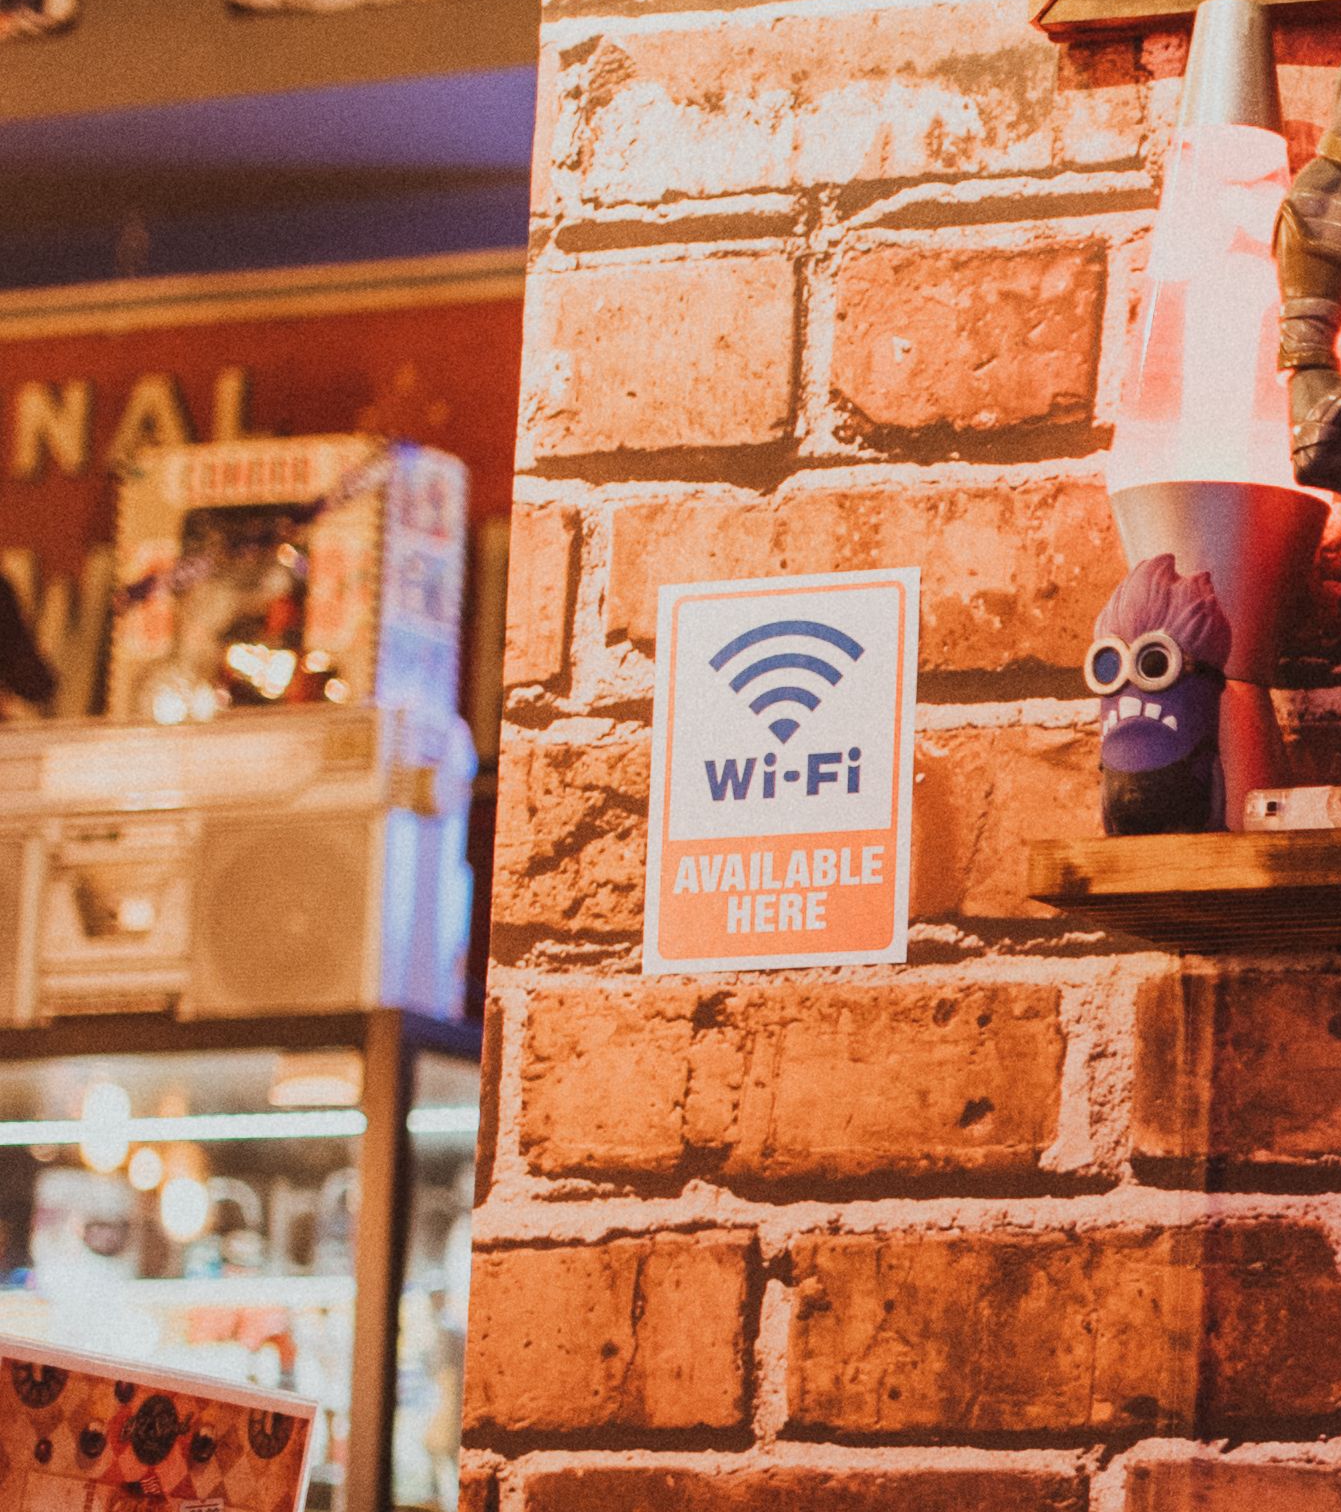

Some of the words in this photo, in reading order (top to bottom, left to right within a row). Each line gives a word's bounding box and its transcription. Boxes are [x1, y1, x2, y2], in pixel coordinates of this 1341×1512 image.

[704, 746, 862, 802] Wi-Fi
[673, 844, 886, 895] AVAILABLE
[726, 891, 828, 935] HERE
